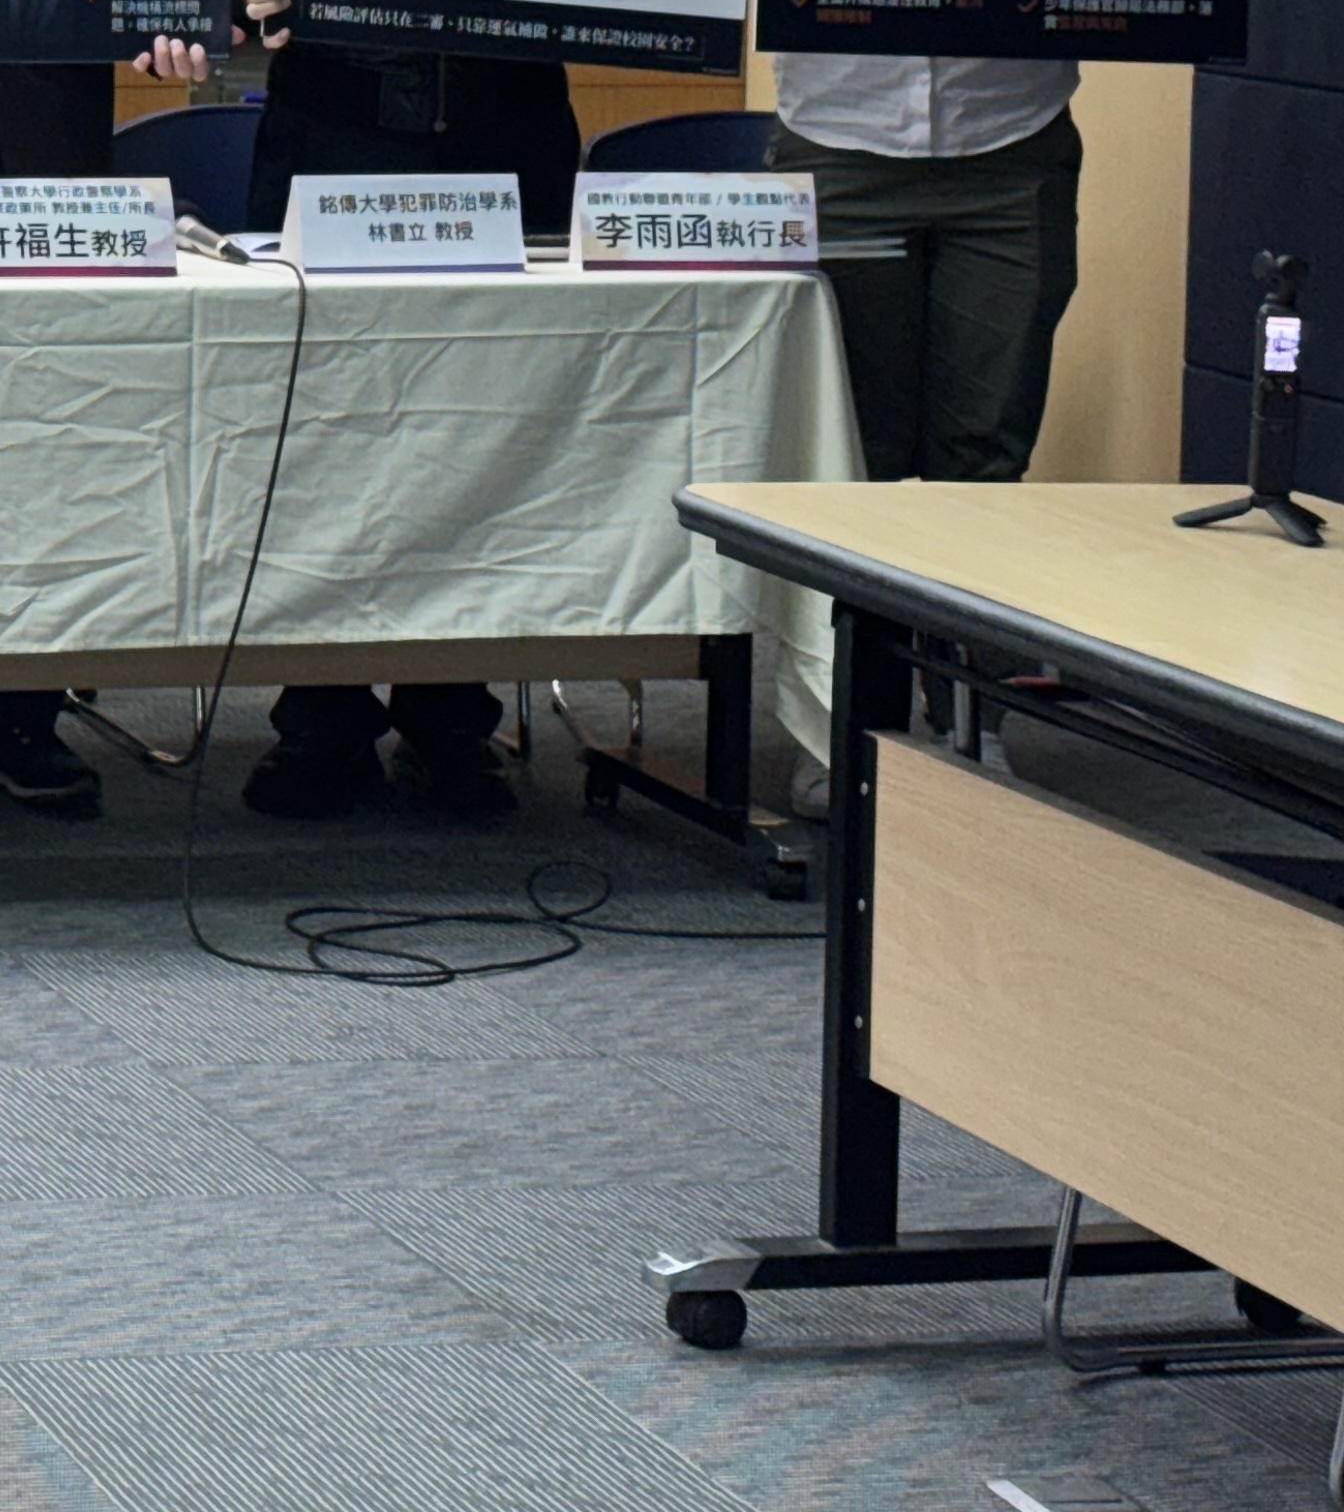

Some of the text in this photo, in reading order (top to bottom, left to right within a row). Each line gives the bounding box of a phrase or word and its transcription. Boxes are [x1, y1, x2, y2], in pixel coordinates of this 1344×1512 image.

[319, 191, 518, 215] 銘傳大學犯罪防治學系
[435, 221, 474, 241] 教授
[595, 213, 807, 249] 李雨函執行長
